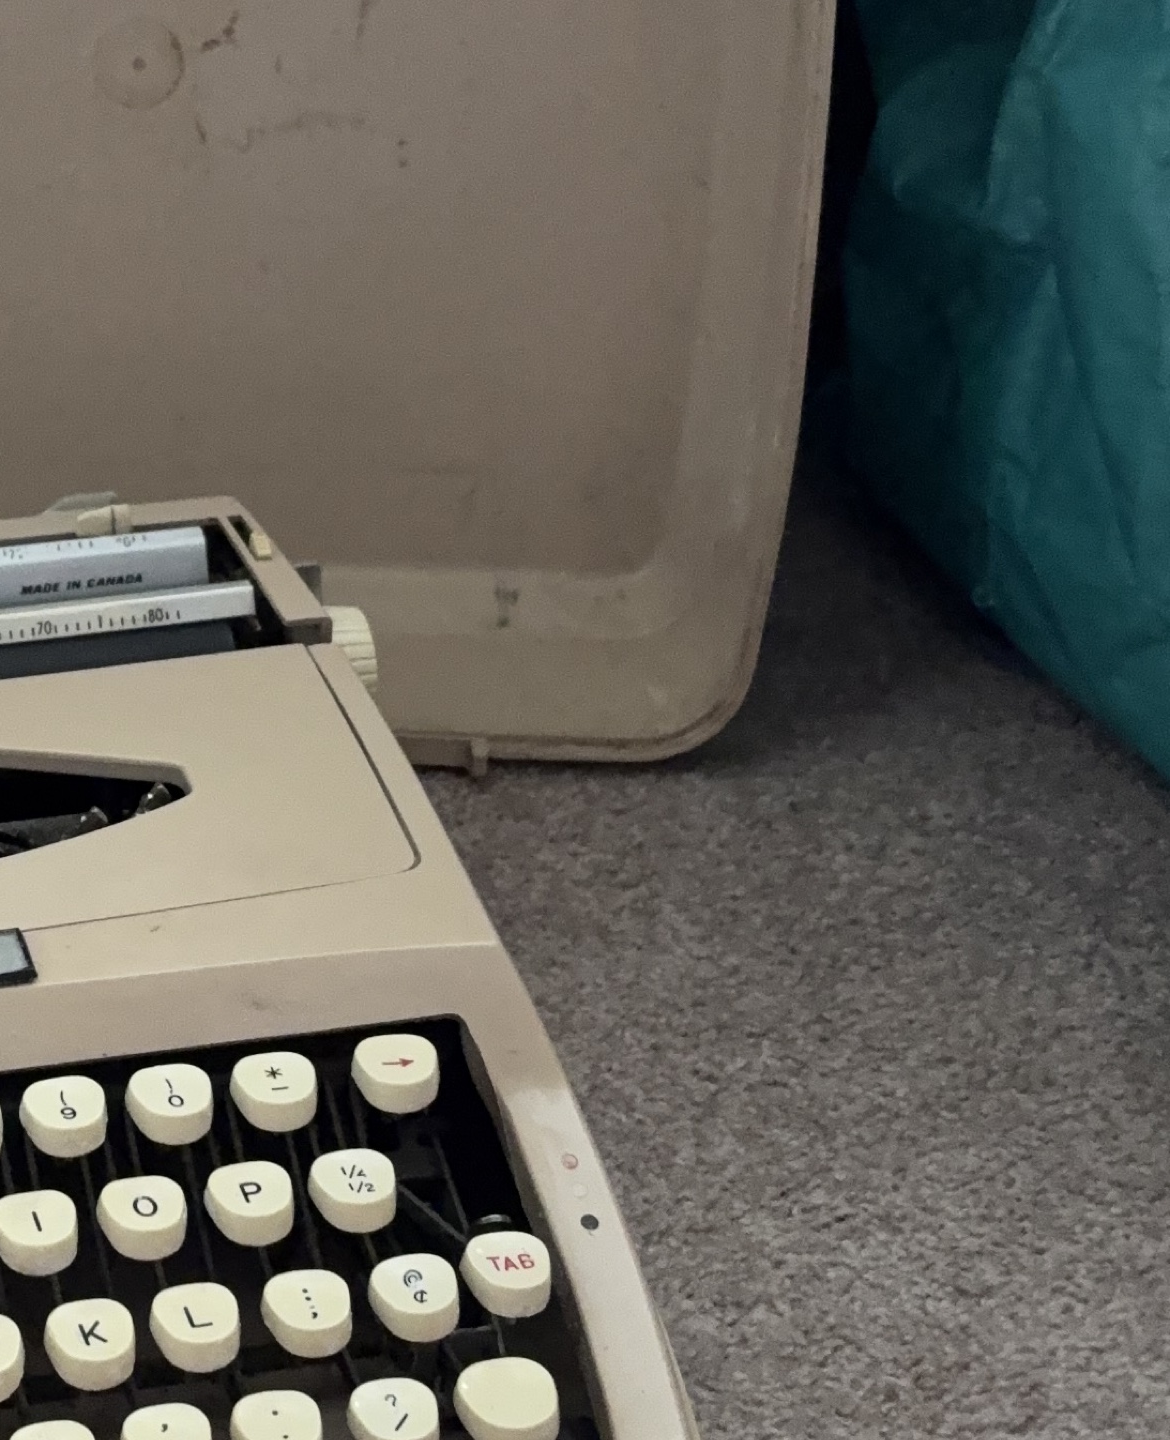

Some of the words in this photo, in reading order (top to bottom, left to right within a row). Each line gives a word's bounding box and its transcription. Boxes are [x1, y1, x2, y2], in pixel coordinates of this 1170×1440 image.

[20, 581, 60, 596] MADE
[66, 578, 82, 592] IN
[86, 572, 143, 589] CANADA
[36, 620, 53, 636] 70
[148, 607, 164, 624] 80
[60, 1106, 77, 1120] 9
[31, 1210, 42, 1232] I
[132, 1195, 158, 1217] O
[239, 1181, 262, 1204] P
[486, 1253, 536, 1272] TAB
[78, 1320, 108, 1346] K
[183, 1306, 213, 1329] L
